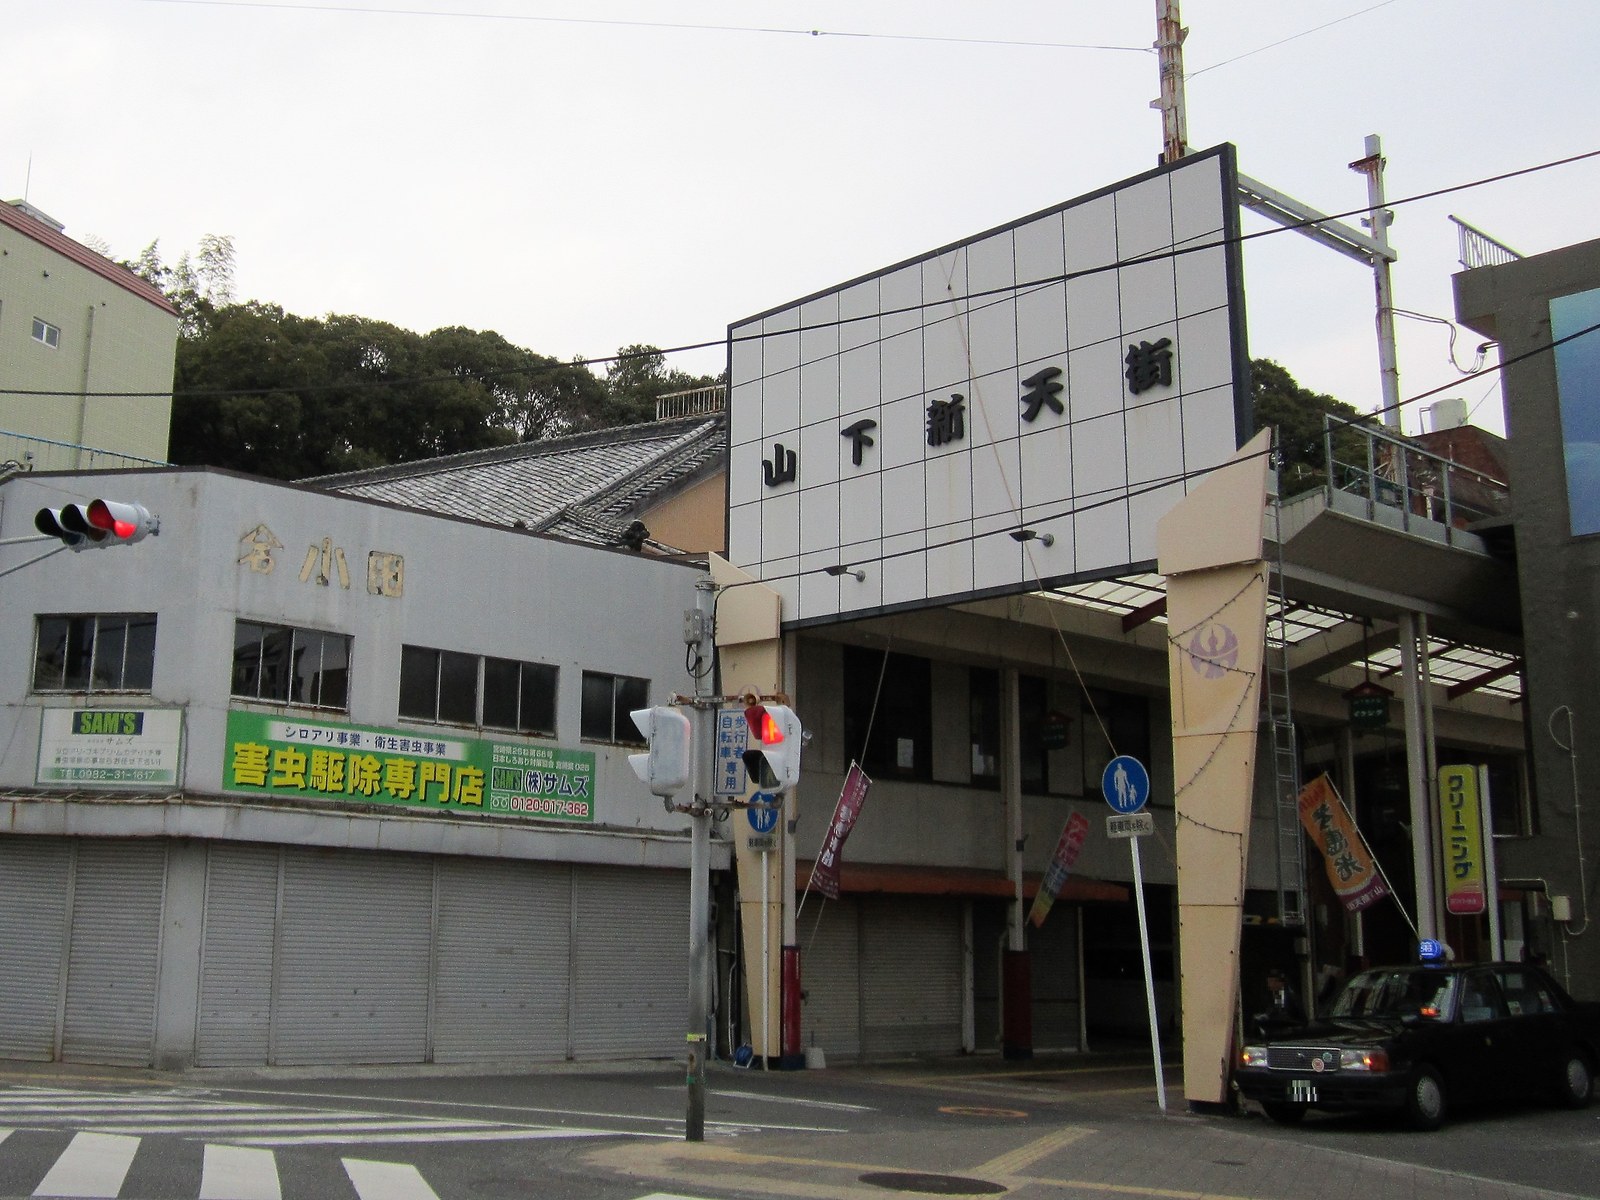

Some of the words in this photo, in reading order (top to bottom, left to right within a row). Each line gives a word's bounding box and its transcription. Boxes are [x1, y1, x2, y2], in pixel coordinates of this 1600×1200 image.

[763, 337, 1173, 488] 山下新天街
[80, 711, 136, 734] SAM'S
[719, 716, 732, 758] 自転車
[285, 726, 446, 756] シロアリ事業・衛生害虫事業
[232, 742, 484, 806] 害虫駆除専門店
[724, 762, 737, 790] 専用
[511, 796, 589, 816] 0120-017-362
[1448, 774, 1473, 879] クリーニング
